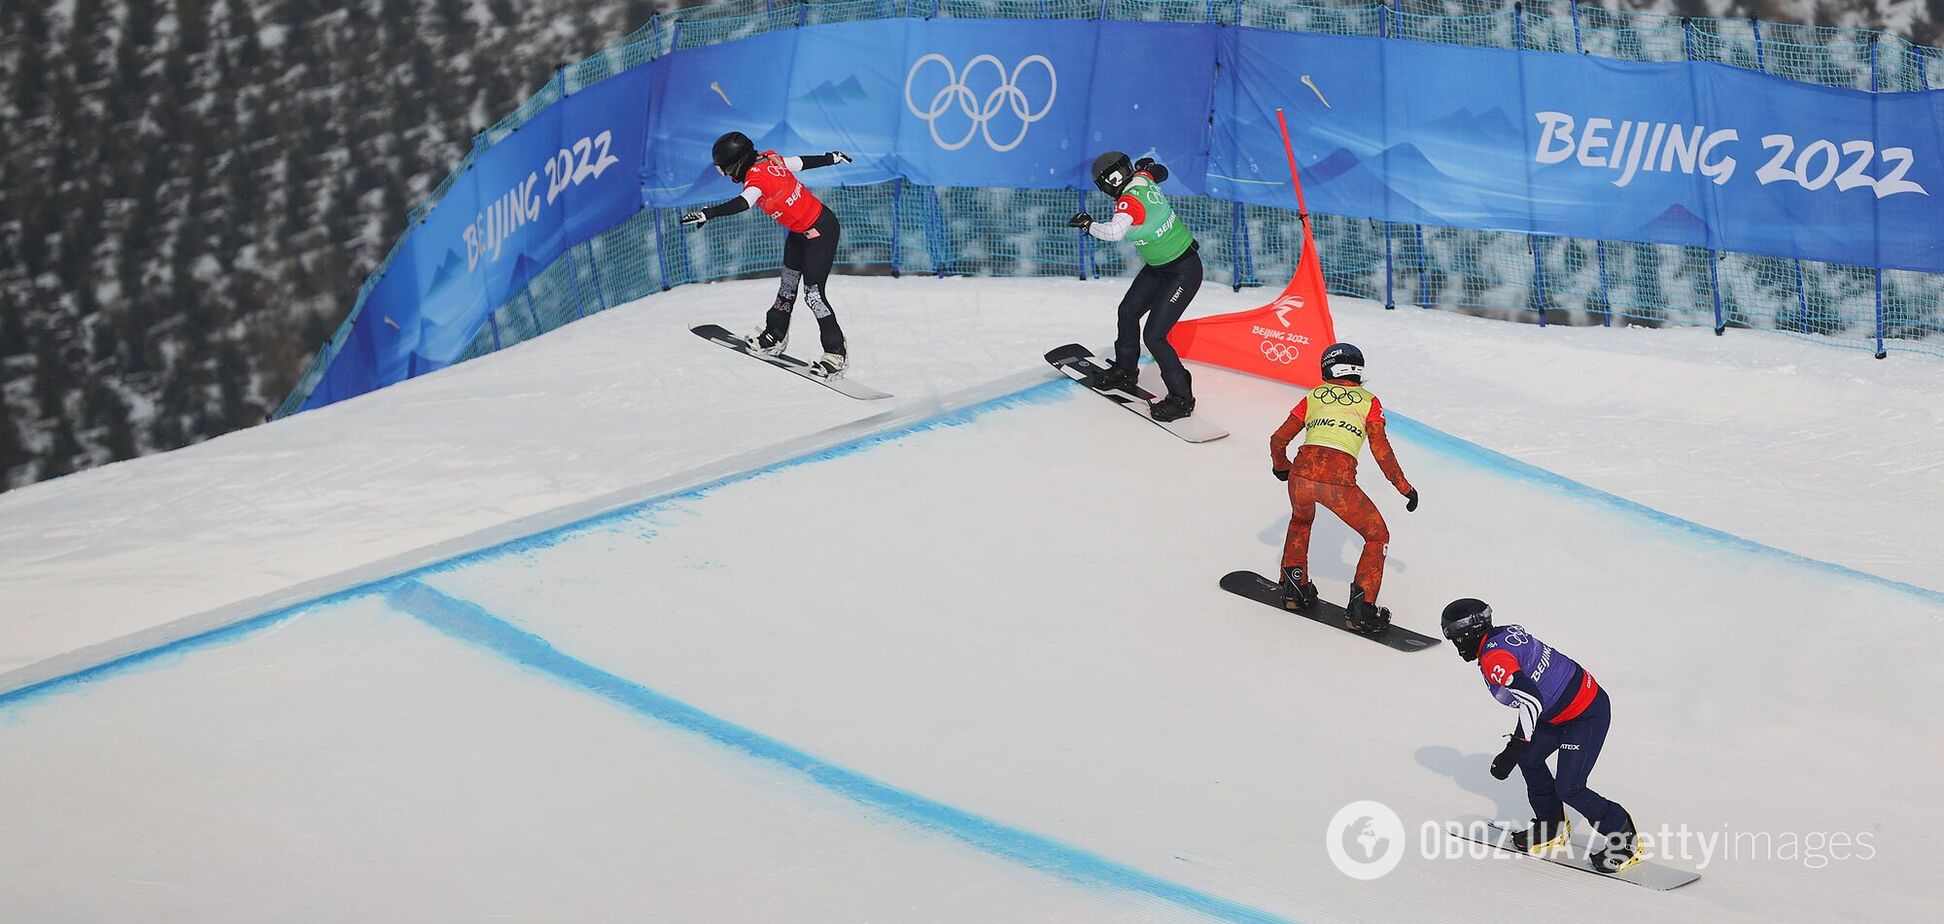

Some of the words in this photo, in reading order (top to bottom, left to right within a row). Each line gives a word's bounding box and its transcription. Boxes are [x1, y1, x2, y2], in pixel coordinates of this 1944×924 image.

[1535, 111, 1739, 188] BEIJING
[1755, 134, 1930, 199] 2022
[463, 171, 540, 272] BEIJING
[544, 129, 619, 206] 2022
[1252, 325, 1285, 341] BEIJING
[1286, 333, 1310, 345] 2022
[1339, 420, 1362, 438] 2022
[1491, 664, 1506, 684] 23
